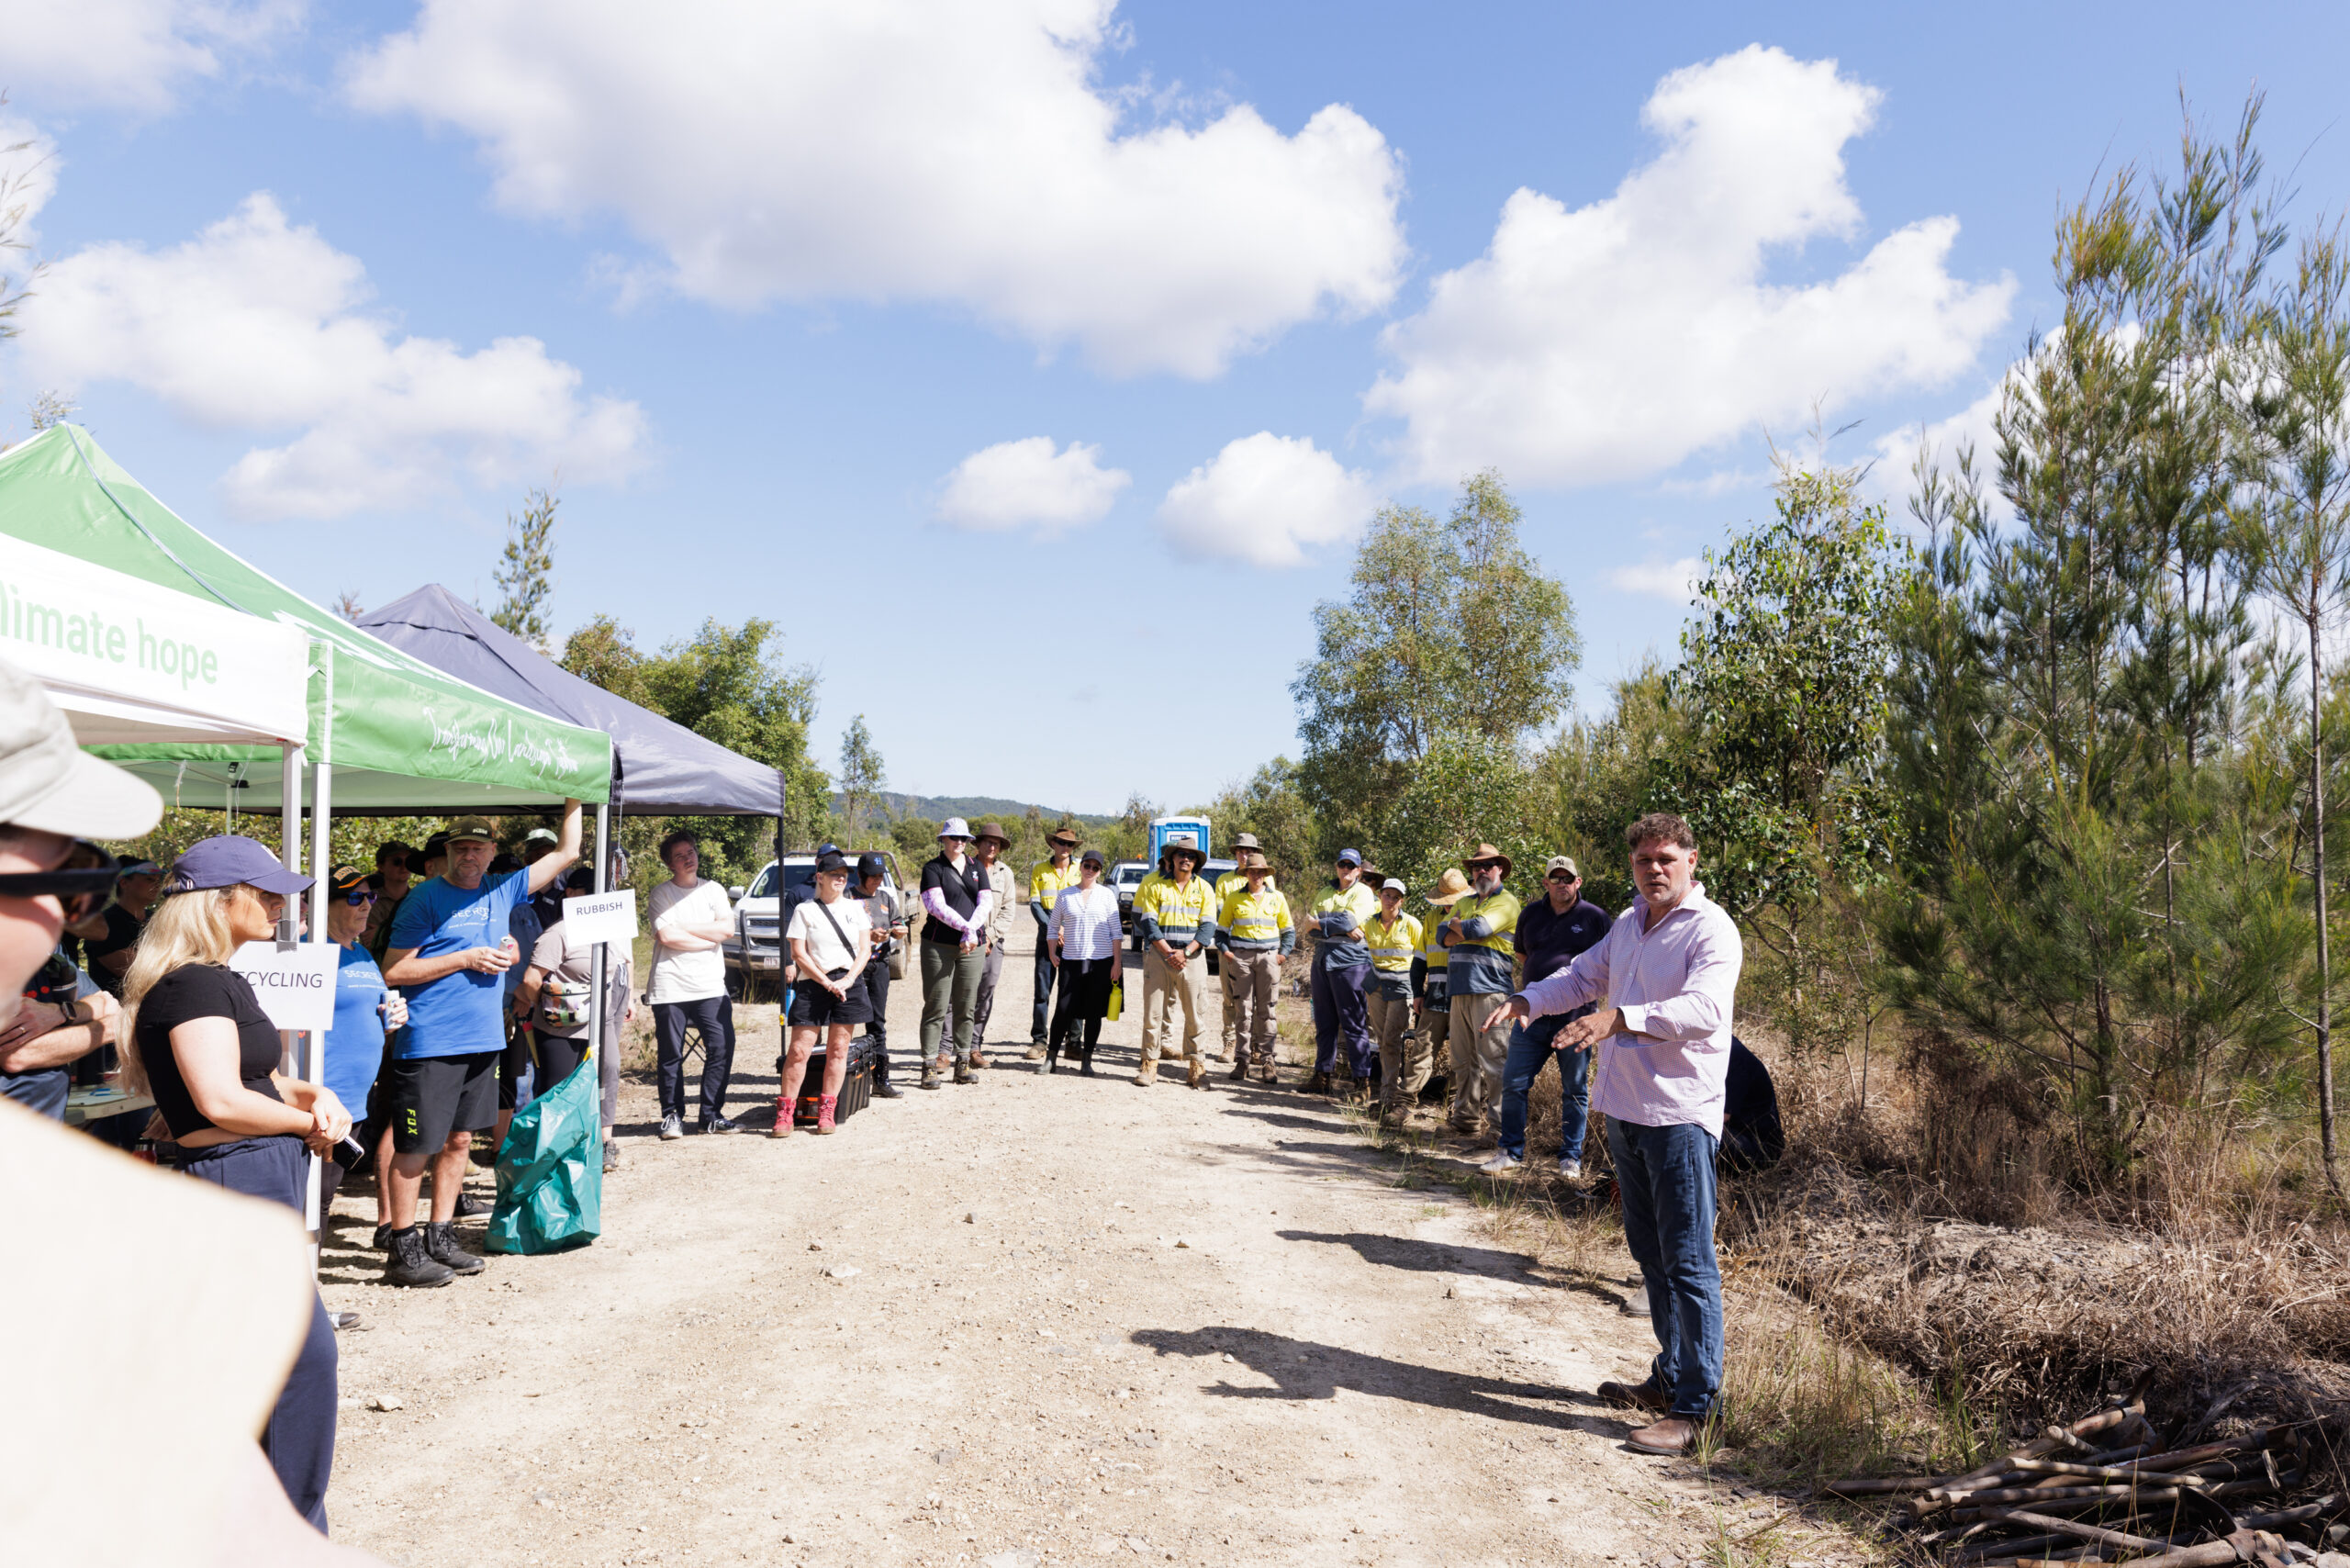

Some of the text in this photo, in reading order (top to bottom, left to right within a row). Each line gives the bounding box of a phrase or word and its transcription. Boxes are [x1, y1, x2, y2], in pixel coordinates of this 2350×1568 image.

[0, 577, 218, 690] limate hope
[576, 902, 623, 915] RUBBISH
[237, 970, 323, 989] CYCLING
[406, 1108, 419, 1136] FOX
